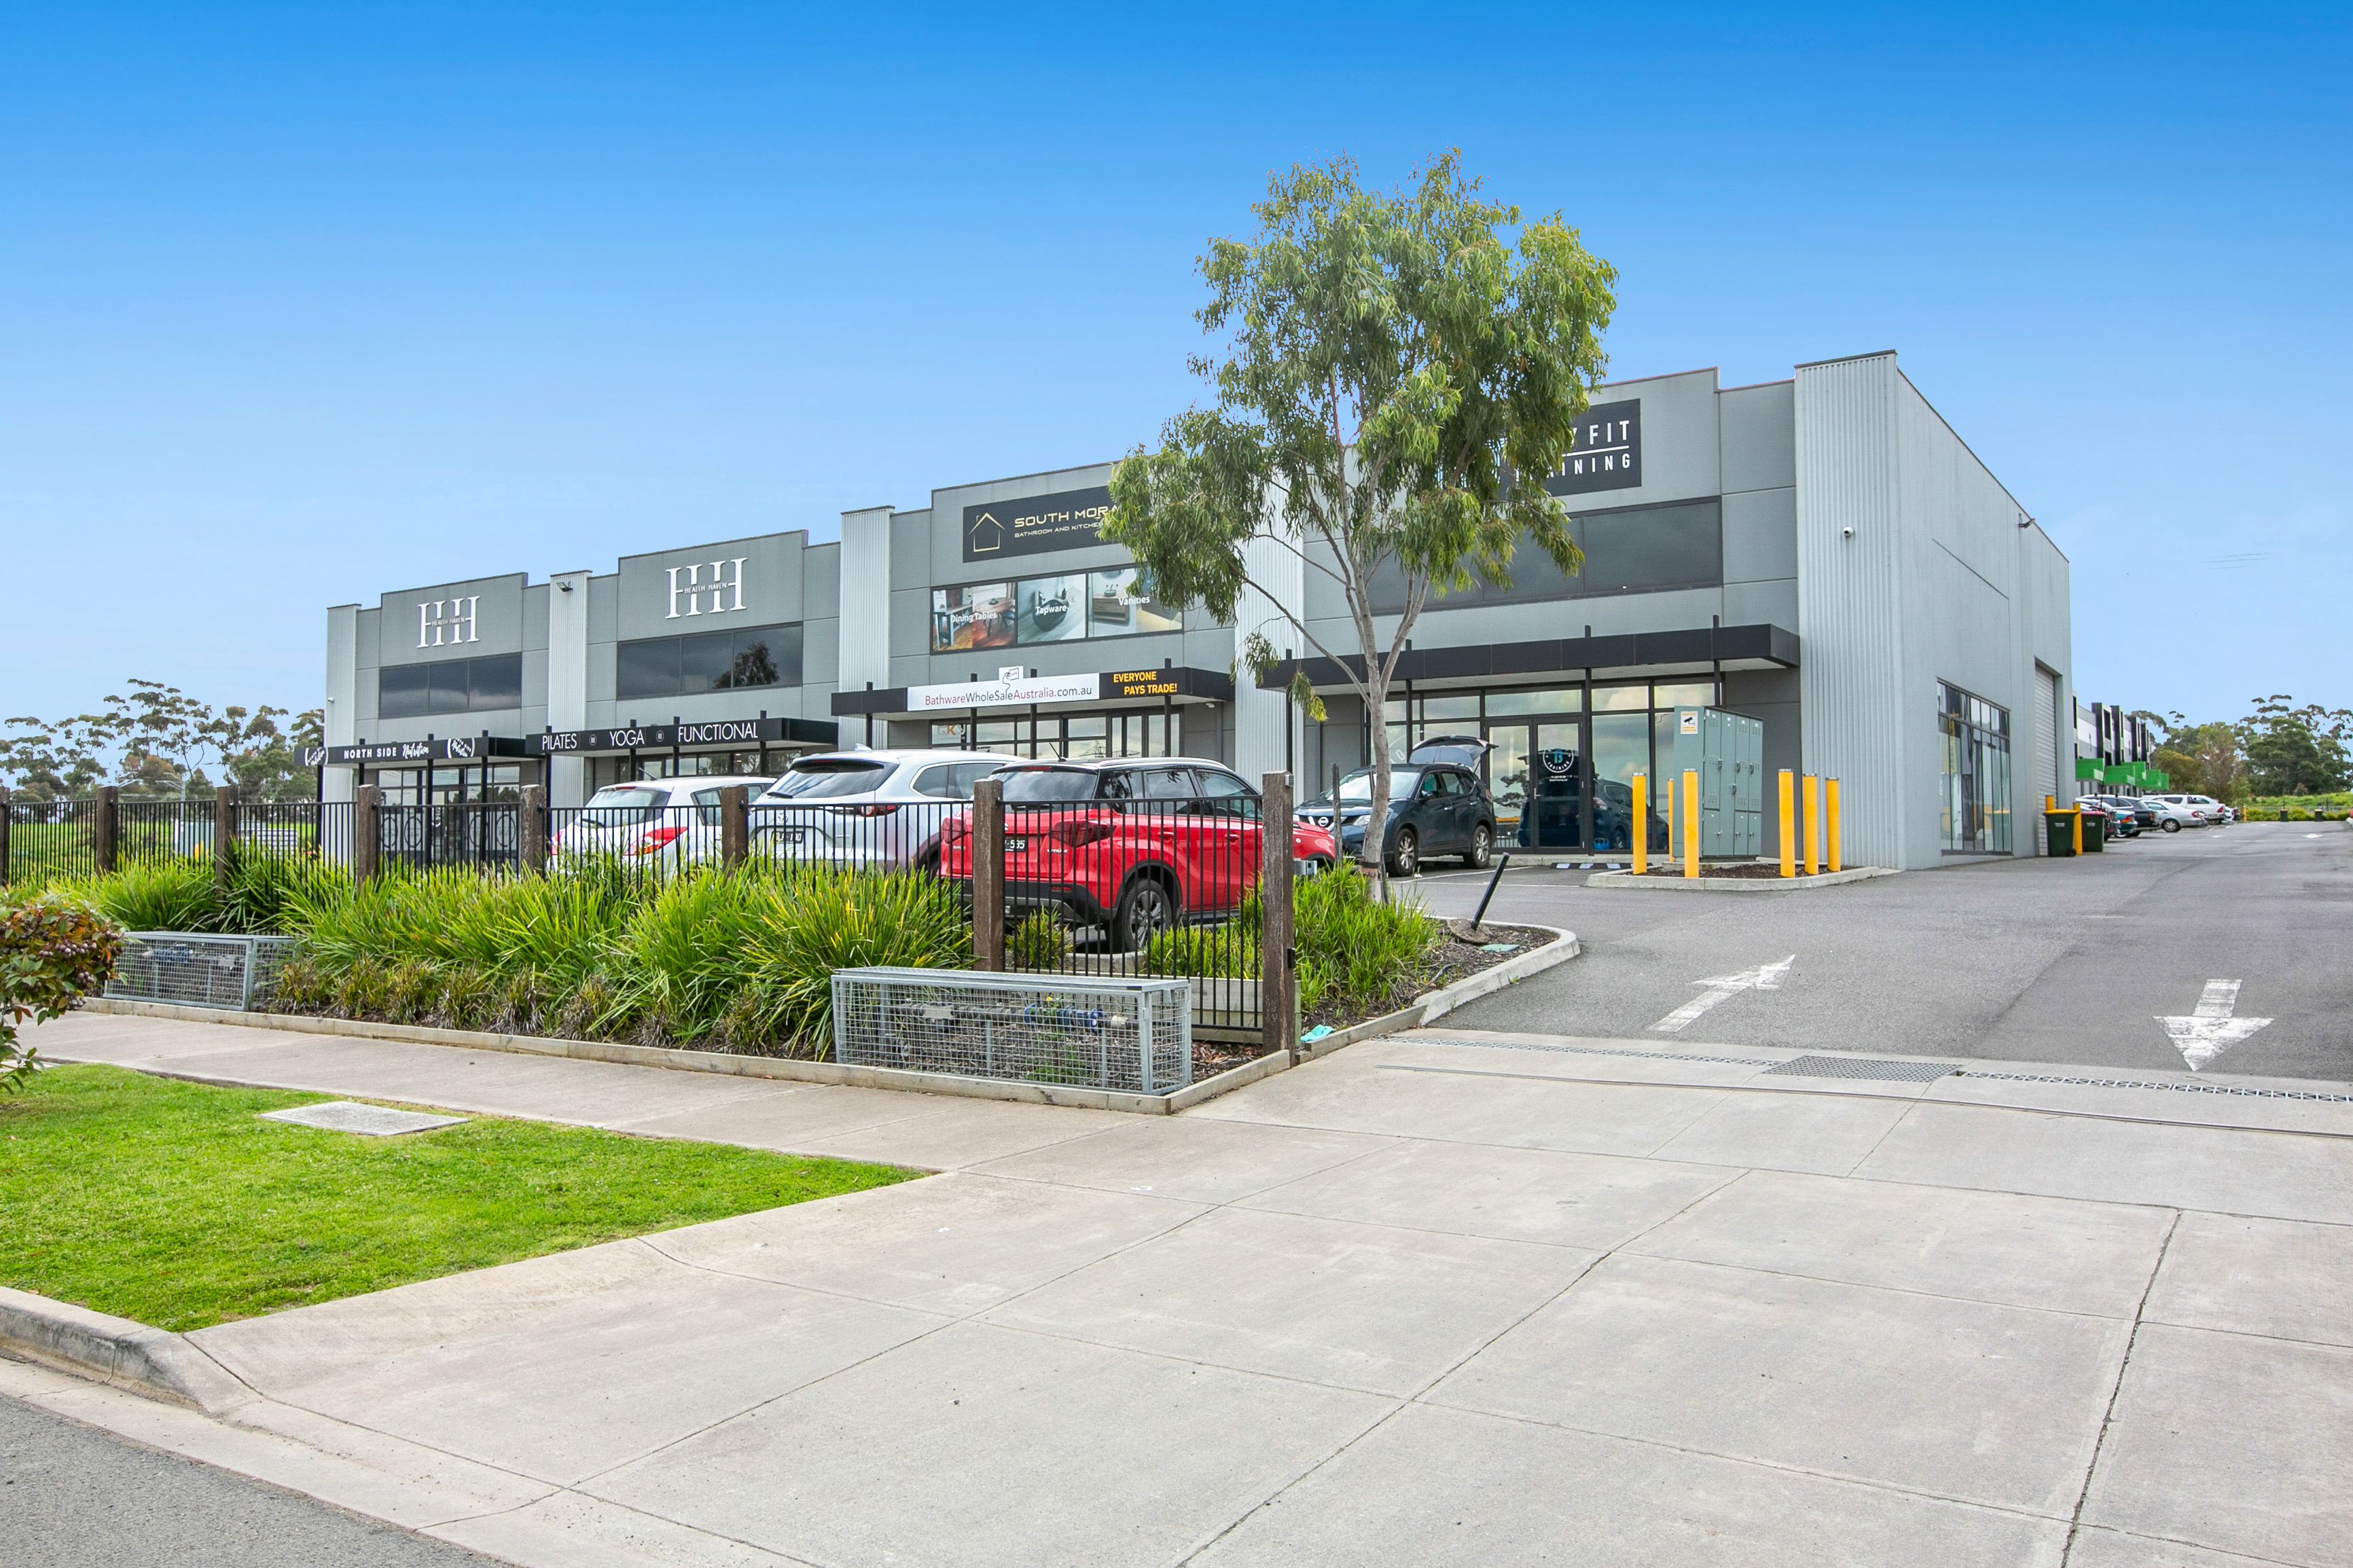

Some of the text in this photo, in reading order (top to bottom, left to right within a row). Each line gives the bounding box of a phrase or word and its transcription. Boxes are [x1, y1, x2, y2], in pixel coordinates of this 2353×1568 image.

[1589, 420, 1630, 445] FIT
[1014, 511, 1069, 528] SOUTH
[1014, 528, 1053, 538] BATHROOM
[684, 582, 728, 594] HEALTH HAVEN
[1118, 596, 1151, 606] Vanities
[1035, 604, 1067, 616] Tapware
[950, 611, 998, 623] Dining Tables
[1113, 671, 1157, 683] EVERYONE
[1124, 683, 1178, 695] PAYS TRADE!
[924, 687, 1092, 706] BathwareWholeSaleAustralia.com.au
[542, 733, 577, 750] PILATES
[609, 729, 645, 746] YOGA
[678, 722, 758, 743] FUNCTIONAL
[344, 742, 430, 759] NORTH SIDE Nutrition
